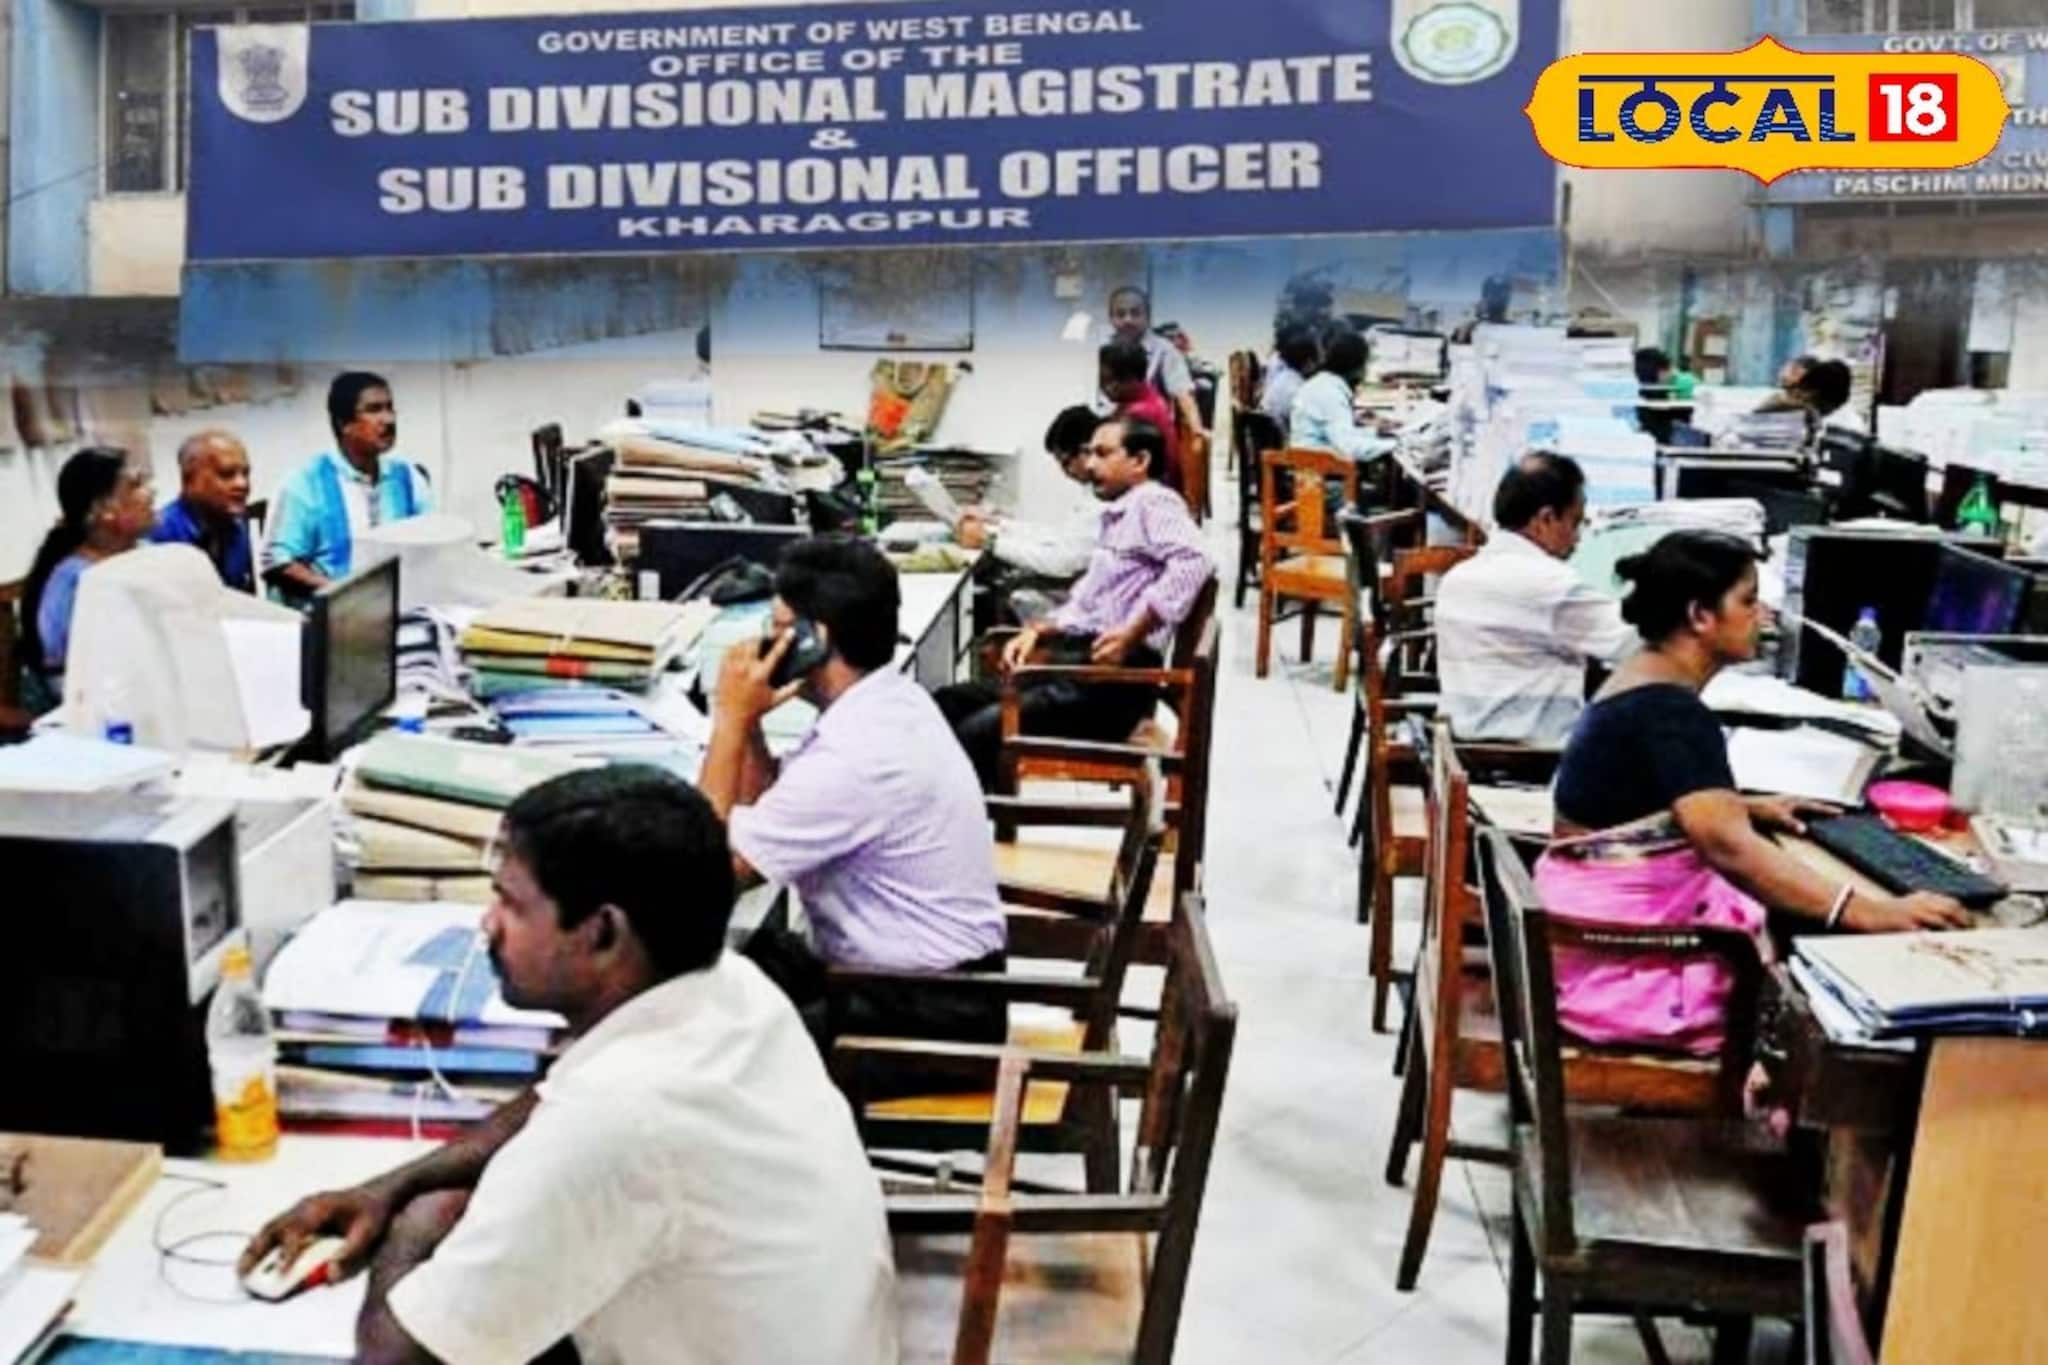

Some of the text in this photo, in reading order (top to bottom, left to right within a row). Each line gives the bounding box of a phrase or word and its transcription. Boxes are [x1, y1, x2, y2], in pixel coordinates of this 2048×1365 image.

[538, 10, 1142, 53] GOVERNMENT OF WEST BENGAL
[1978, 31, 2021, 50] OF
[650, 43, 1022, 77] OFFICE OF THE
[331, 54, 1372, 135] SUB DIVISIONAL MAGISTRATE
[809, 128, 857, 150] &
[379, 141, 1320, 213] SUB DIVISIONAL OFFICER
[1834, 173, 1968, 194] PASCHIM
[618, 208, 1029, 237] KHARAGPUR
